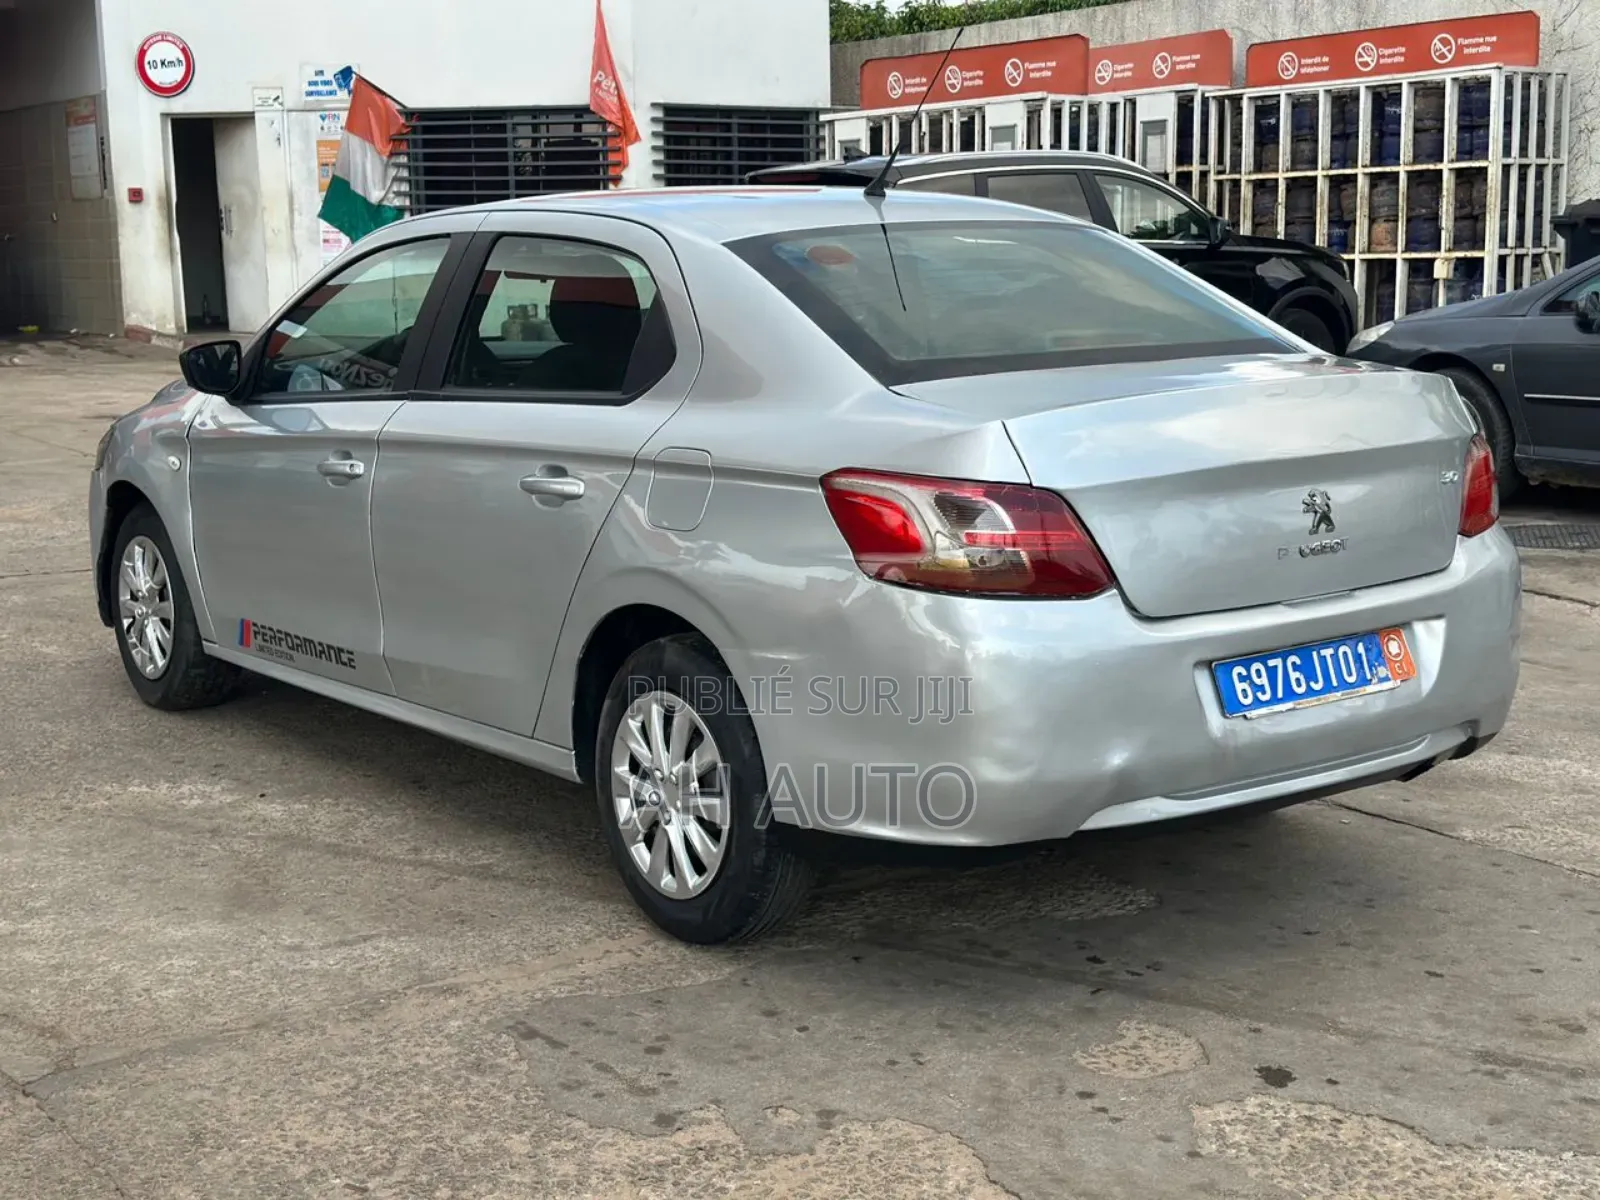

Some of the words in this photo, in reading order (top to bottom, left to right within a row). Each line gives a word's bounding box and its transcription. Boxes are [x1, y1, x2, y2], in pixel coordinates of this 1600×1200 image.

[1457, 37, 1484, 46] Flamme
[1484, 35, 1497, 43] nue
[1378, 46, 1406, 56] Cigarette
[147, 59, 158, 70] 10
[160, 57, 184, 69] Km/h
[1300, 57, 1320, 65] Interdit
[1277, 537, 1349, 559] PUGEOT
[252, 621, 356, 669] PERFORMANCE
